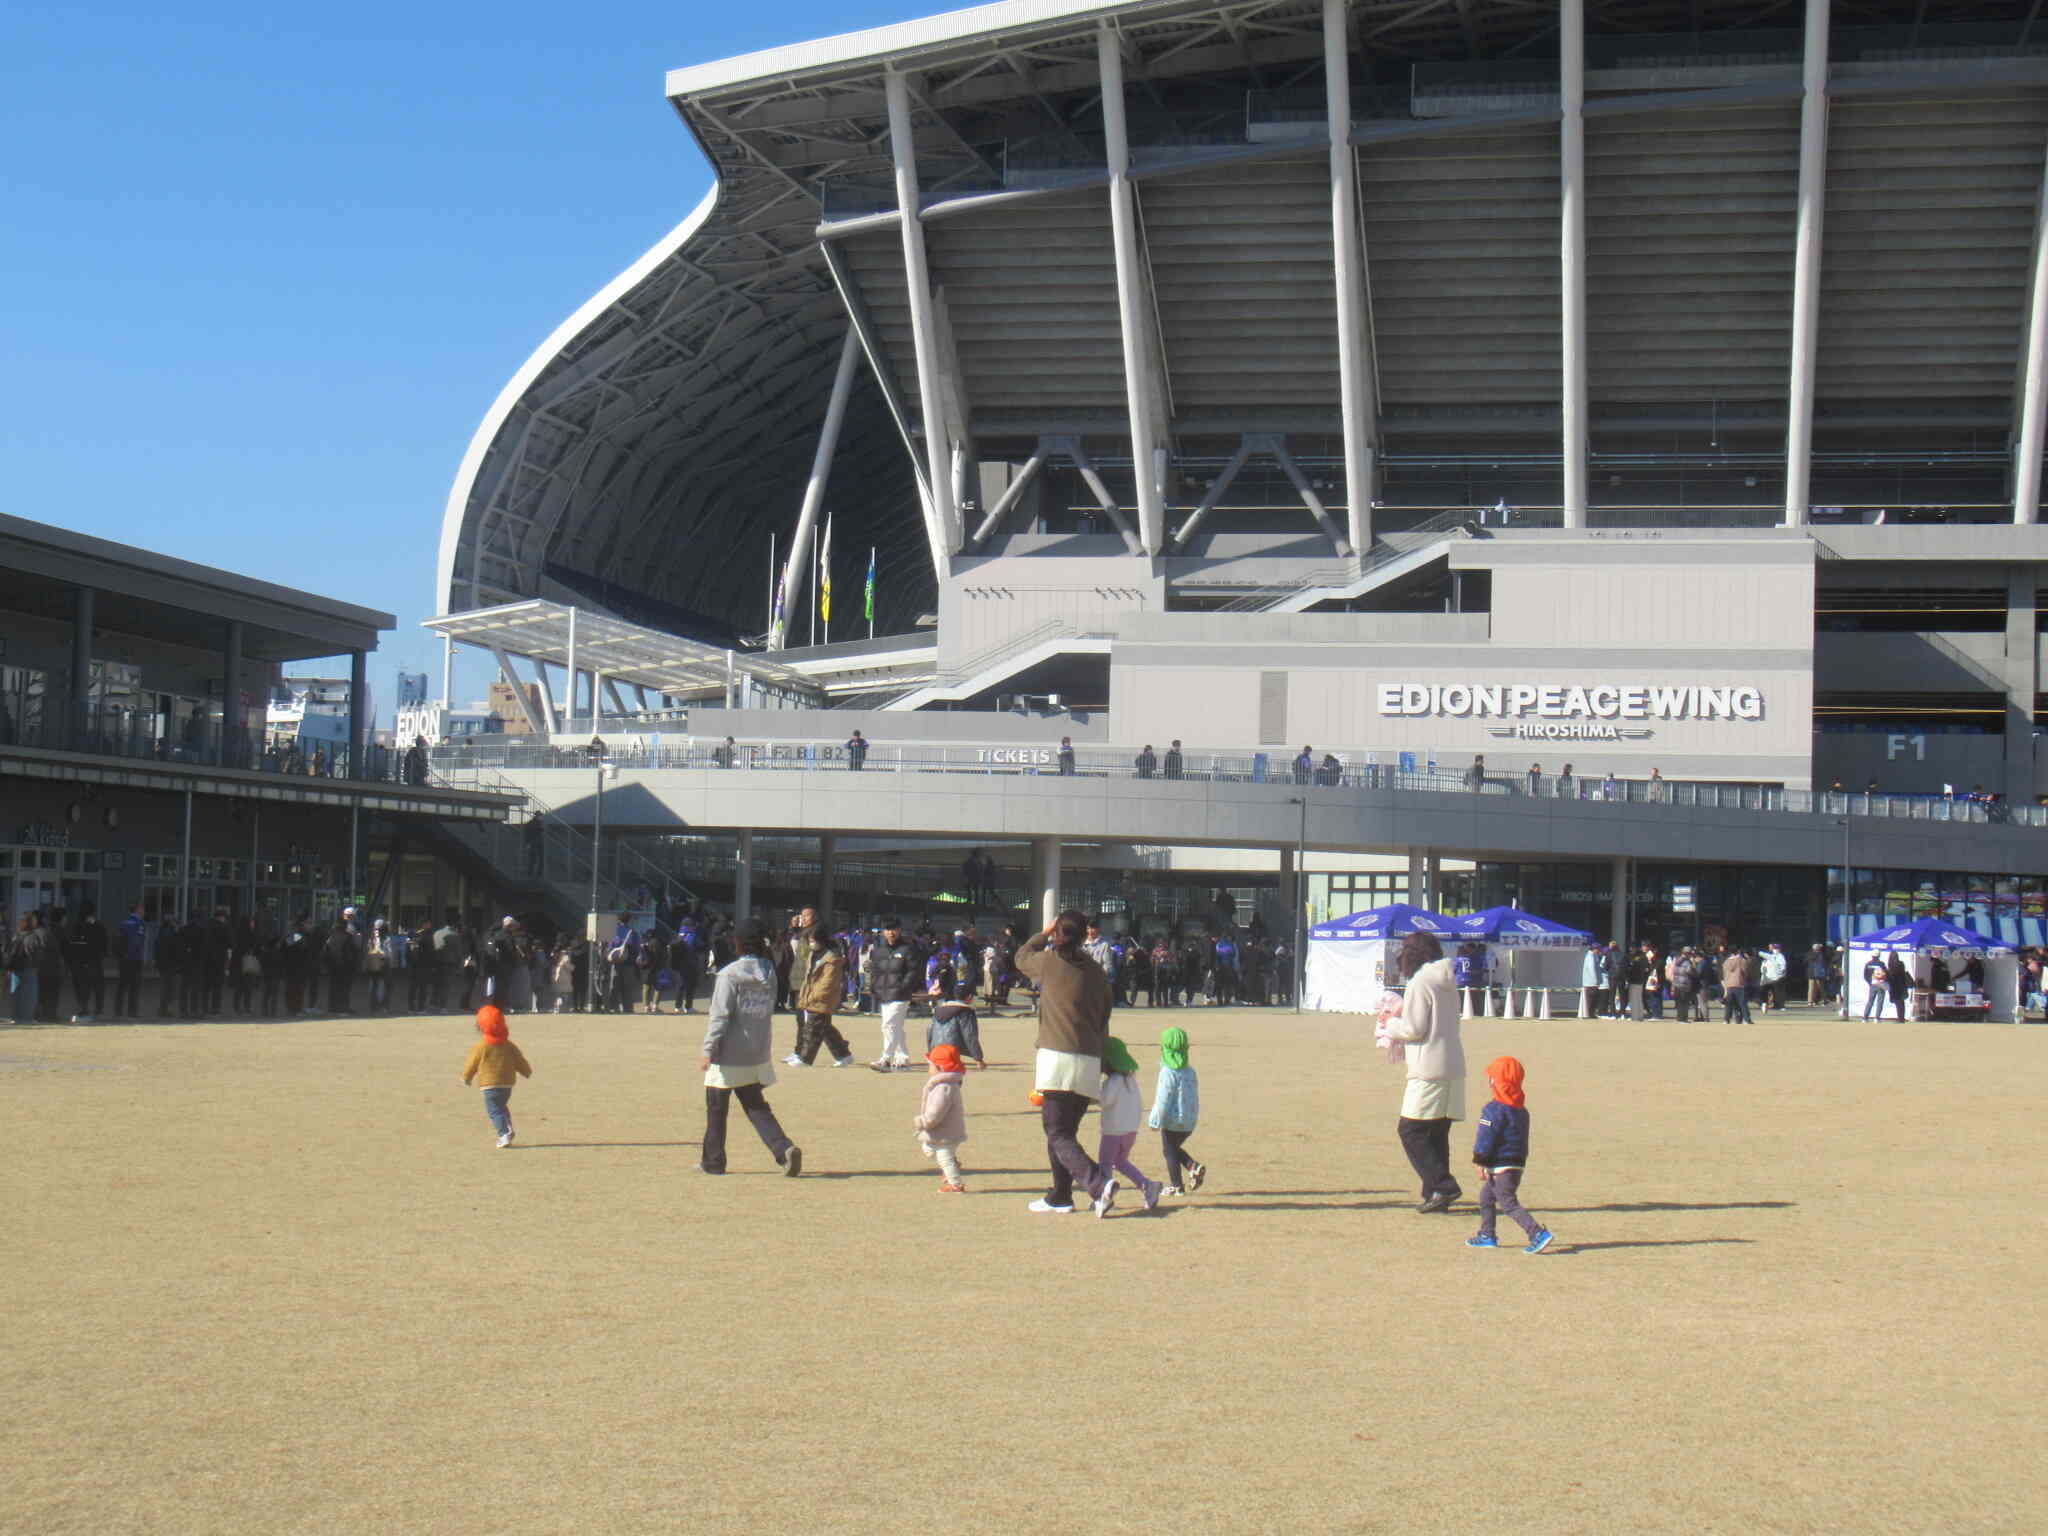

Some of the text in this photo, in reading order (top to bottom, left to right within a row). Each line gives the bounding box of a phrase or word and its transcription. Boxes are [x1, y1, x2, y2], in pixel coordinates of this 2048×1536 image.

[1376, 683, 1762, 718] EDION PEACE WING
[397, 710, 441, 738] EDION
[1516, 723, 1617, 738] HIROSHIMA
[975, 749, 1050, 763] TICKETS
[1887, 734, 1925, 760] F1
